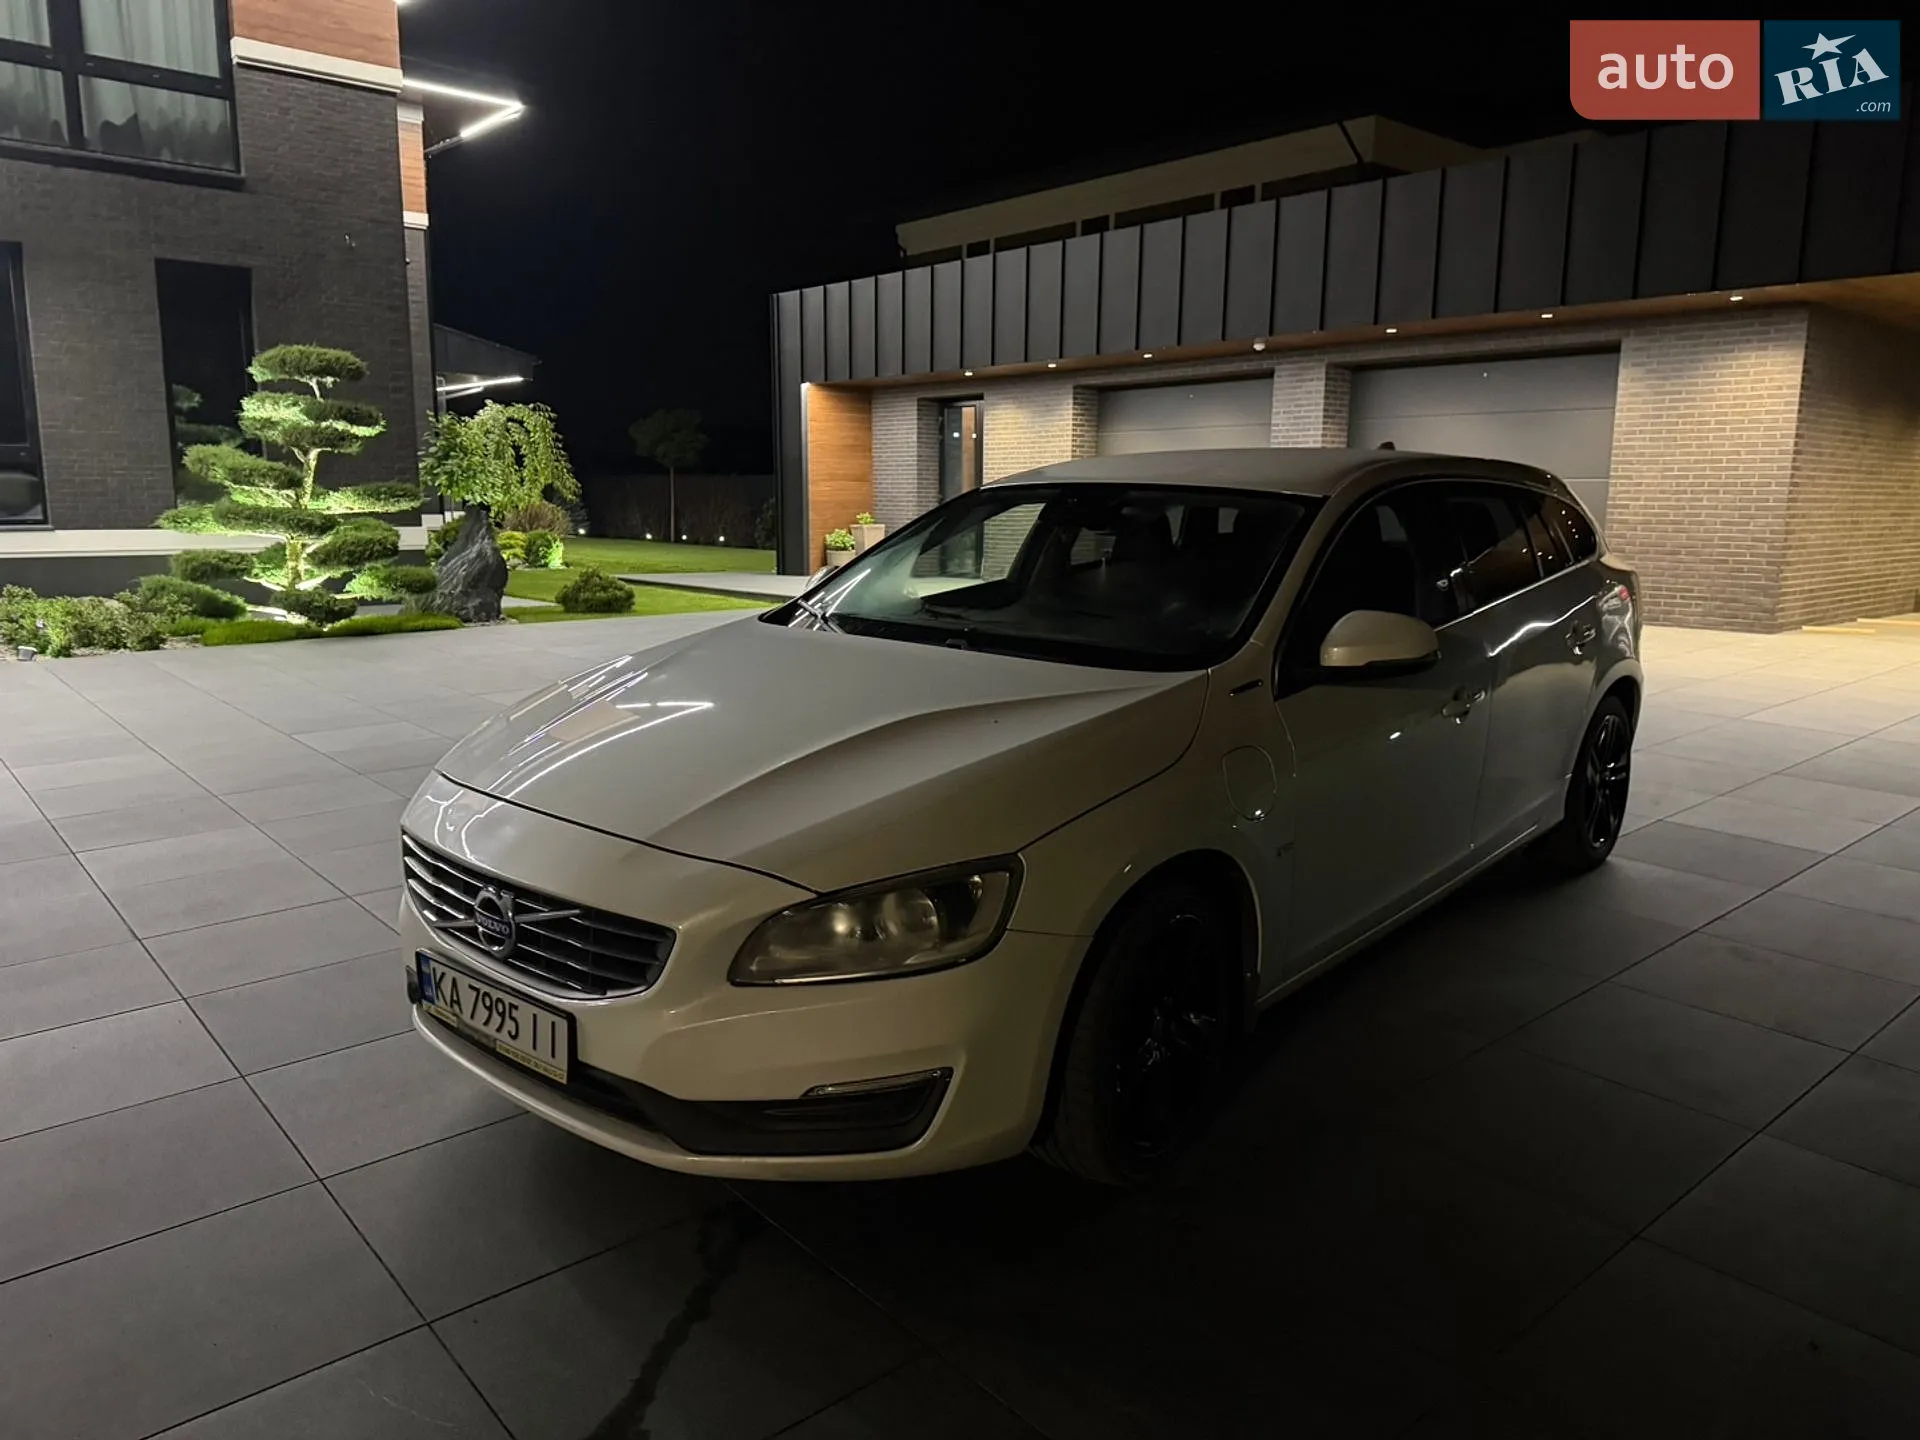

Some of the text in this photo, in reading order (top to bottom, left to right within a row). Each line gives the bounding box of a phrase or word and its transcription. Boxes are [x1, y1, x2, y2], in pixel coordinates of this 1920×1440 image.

[433, 968, 556, 1059] KA 7995 II
